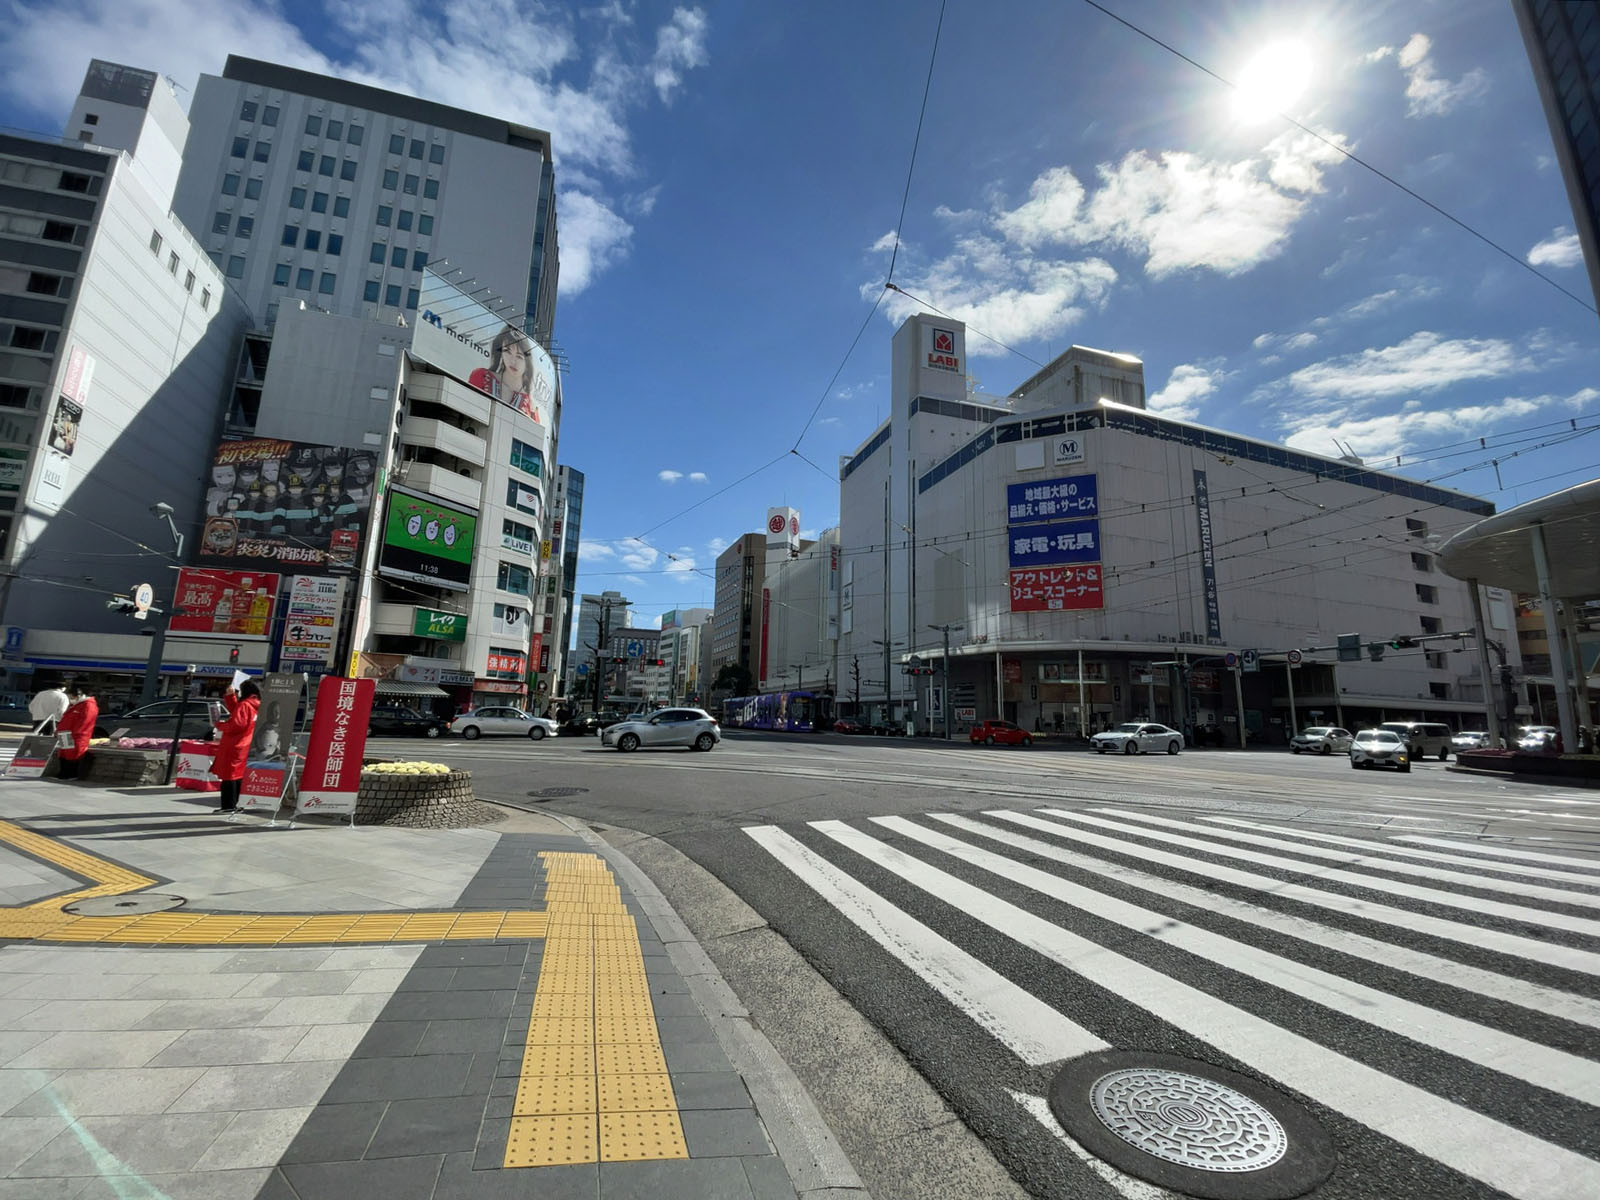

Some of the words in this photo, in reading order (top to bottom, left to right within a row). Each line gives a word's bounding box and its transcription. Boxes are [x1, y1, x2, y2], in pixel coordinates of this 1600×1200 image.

[446, 326, 490, 358] marimo
[928, 353, 959, 367] LABI
[1024, 483, 1078, 501] 地域最大級の
[1009, 496, 1096, 519] 品揃え・価格・サービス
[1013, 532, 1095, 555] 家電・玩具
[1199, 507, 1213, 568] MARUZEN
[1012, 568, 1099, 586] アウトレット&
[183, 590, 214, 606] 最高
[1012, 585, 1100, 600] リユースコーナー
[430, 612, 455, 624] レイク
[428, 623, 454, 634] ALSA
[196, 666, 240, 675] LAWSON
[322, 680, 357, 788] 国境なき医師団
